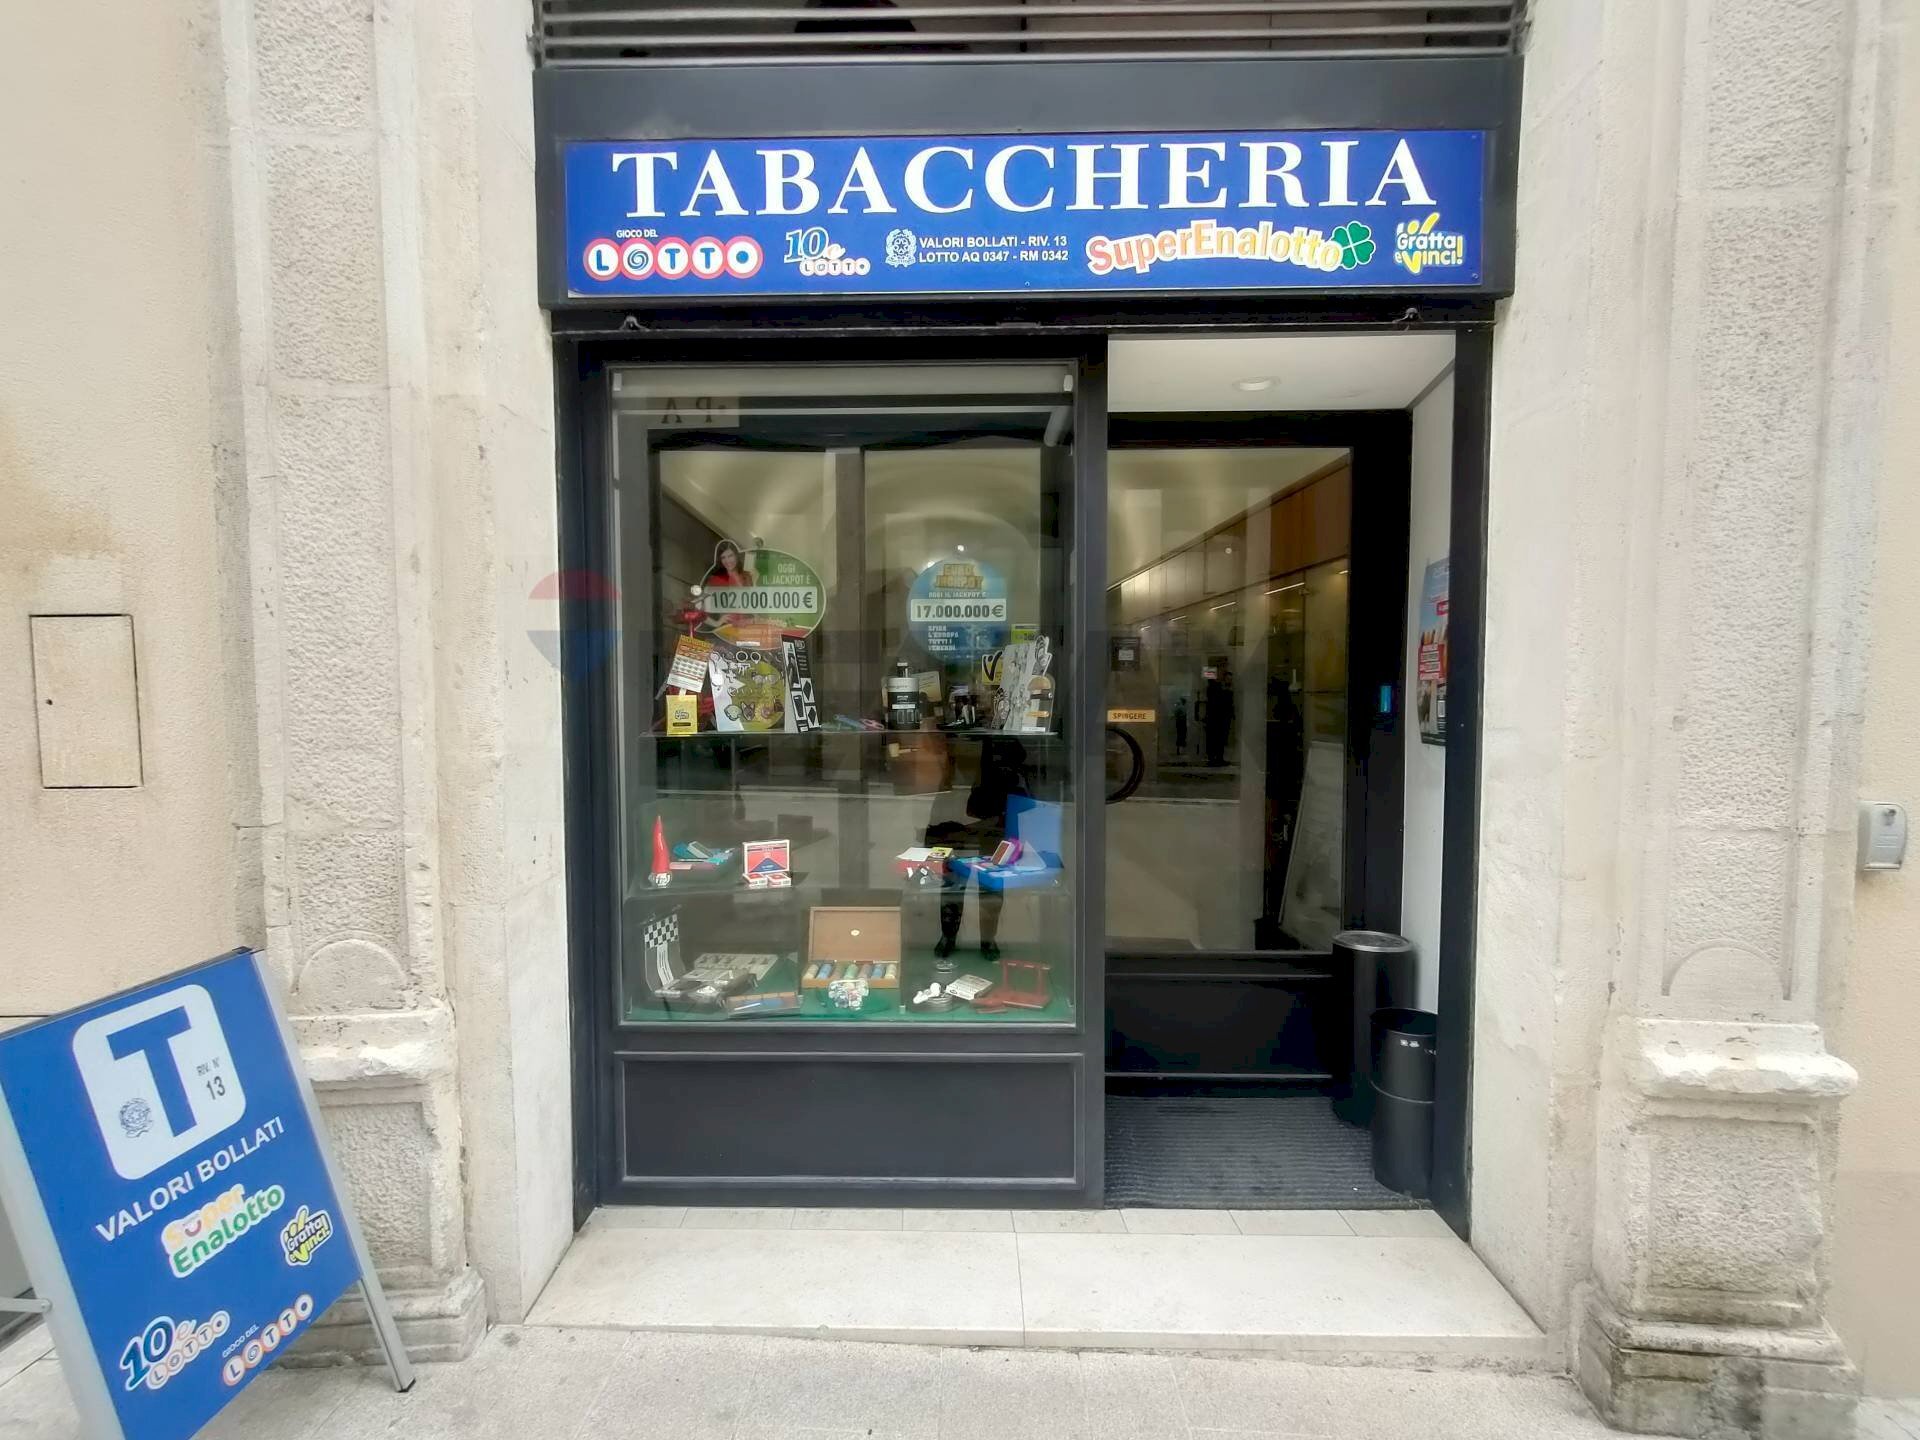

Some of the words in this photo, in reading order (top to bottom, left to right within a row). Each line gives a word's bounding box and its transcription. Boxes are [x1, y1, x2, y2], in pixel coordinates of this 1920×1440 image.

[611, 137, 1437, 219] TABACCHERIA
[616, 228, 643, 239] GIOCO
[644, 228, 658, 239] DEL
[919, 237, 964, 249] VALORI
[967, 236, 1018, 248] BOLLATI
[1028, 236, 1051, 247] RIV.
[1054, 236, 1067, 247] 13
[1397, 232, 1457, 250] Gratta
[919, 252, 960, 263] LOTTO
[961, 251, 981, 263] AQ
[983, 251, 1009, 262] 0347
[1020, 250, 1039, 262] RM
[1041, 250, 1069, 261] 0342
[1087, 219, 1342, 274] SuperEnalotto
[583, 235, 763, 281] LOTTO
[799, 257, 871, 277] LOTTO
[777, 563, 796, 574] OGGI
[772, 575, 804, 585] JACKPOT
[107, 1006, 198, 1138] T
[206, 1076, 226, 1101] 13
[95, 1171, 195, 1242] VALORI
[196, 1116, 285, 1183] BOLLATI
[173, 1187, 285, 1275] Enalotto
[222, 1293, 313, 1386] LOTTO
[245, 1323, 259, 1339] DEL
